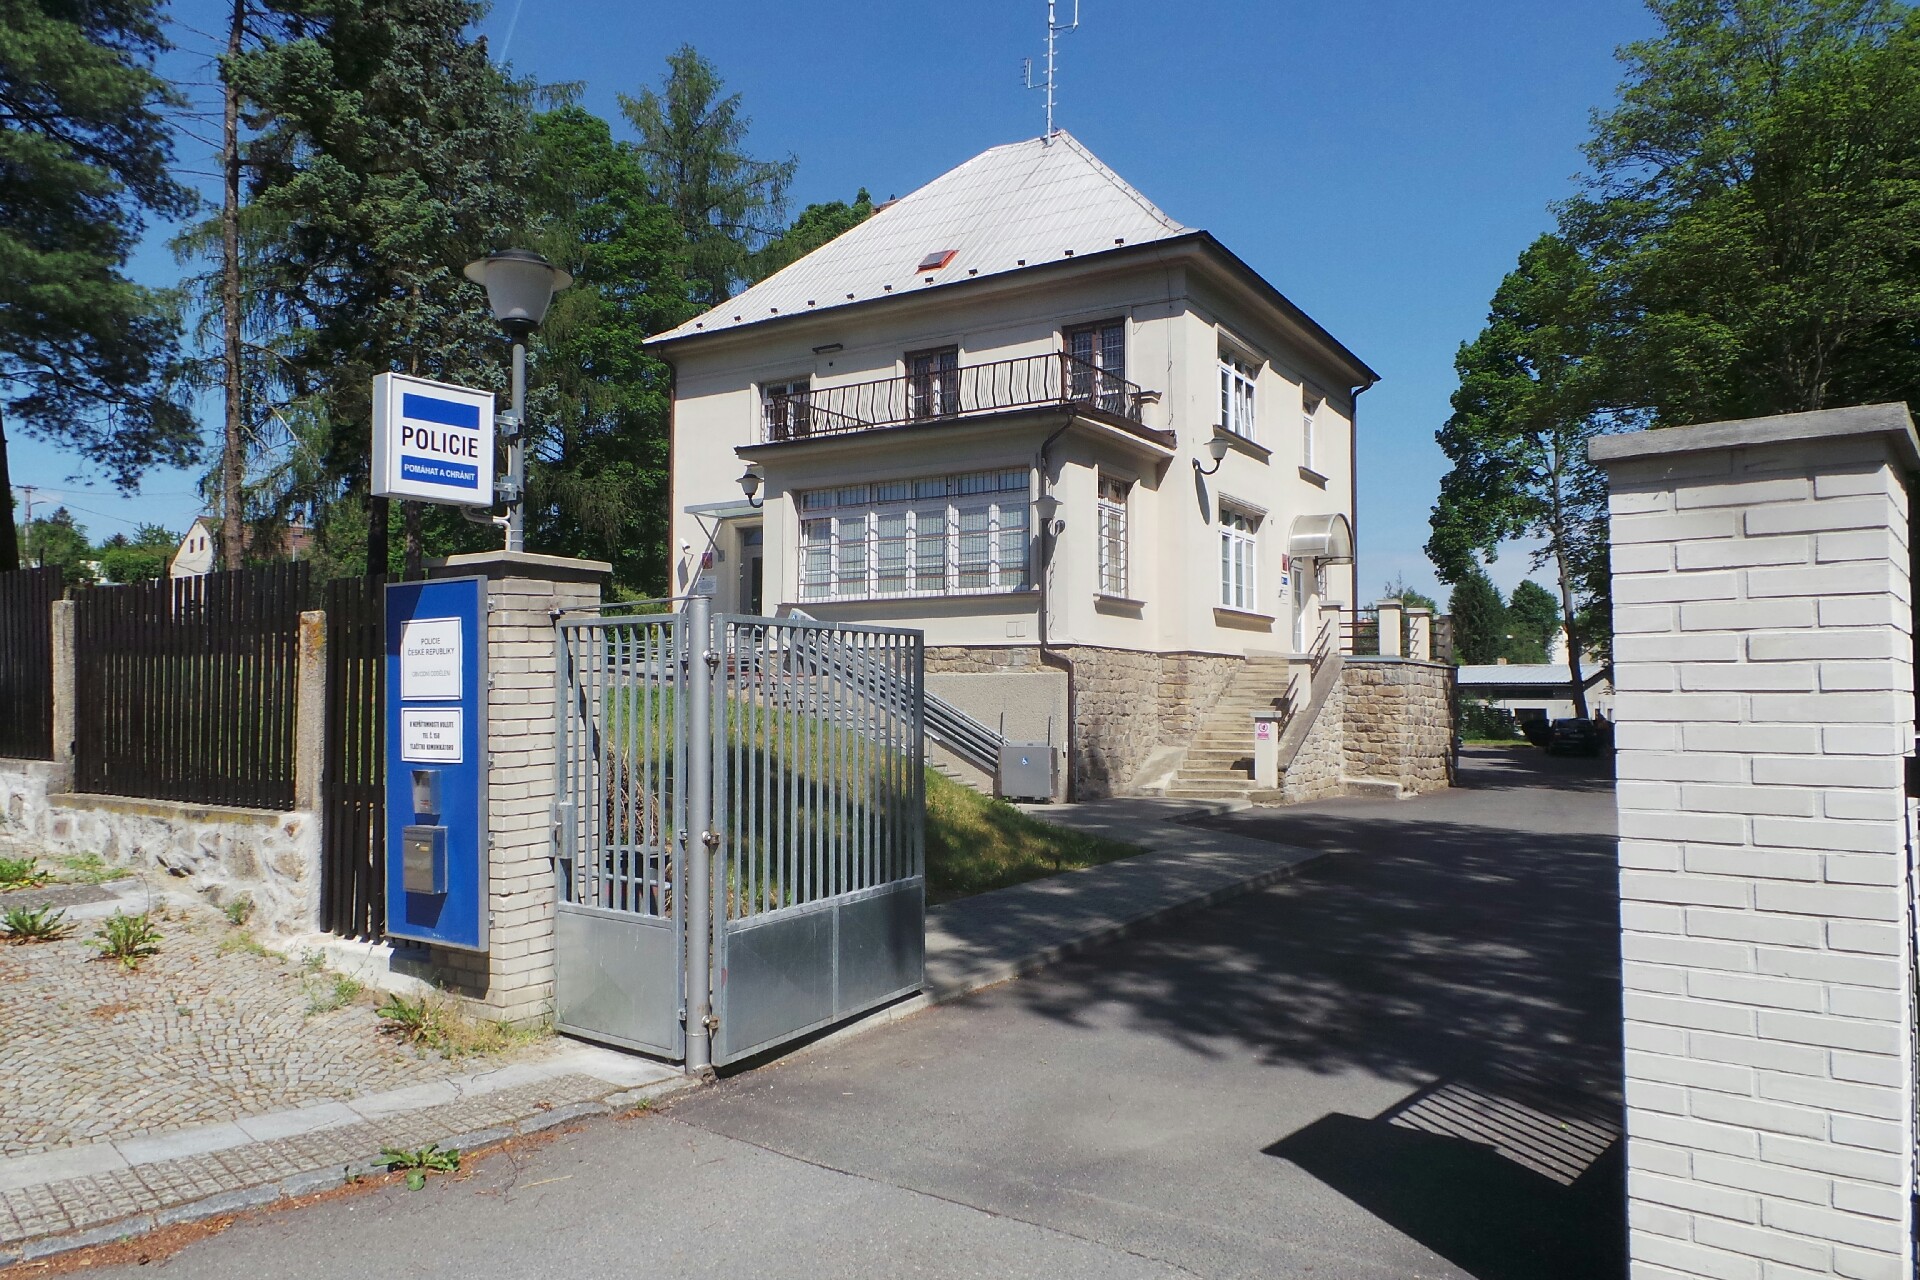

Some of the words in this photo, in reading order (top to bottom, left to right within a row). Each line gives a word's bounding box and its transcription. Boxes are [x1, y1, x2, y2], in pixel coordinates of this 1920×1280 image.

[402, 425, 478, 458] POLICIE
[404, 463, 439, 476] POMÁHAT
[440, 468, 445, 476] A
[446, 468, 475, 481] CHRÁNIT
[421, 637, 441, 645] POLICIE
[426, 647, 455, 656] REPUBLIKY
